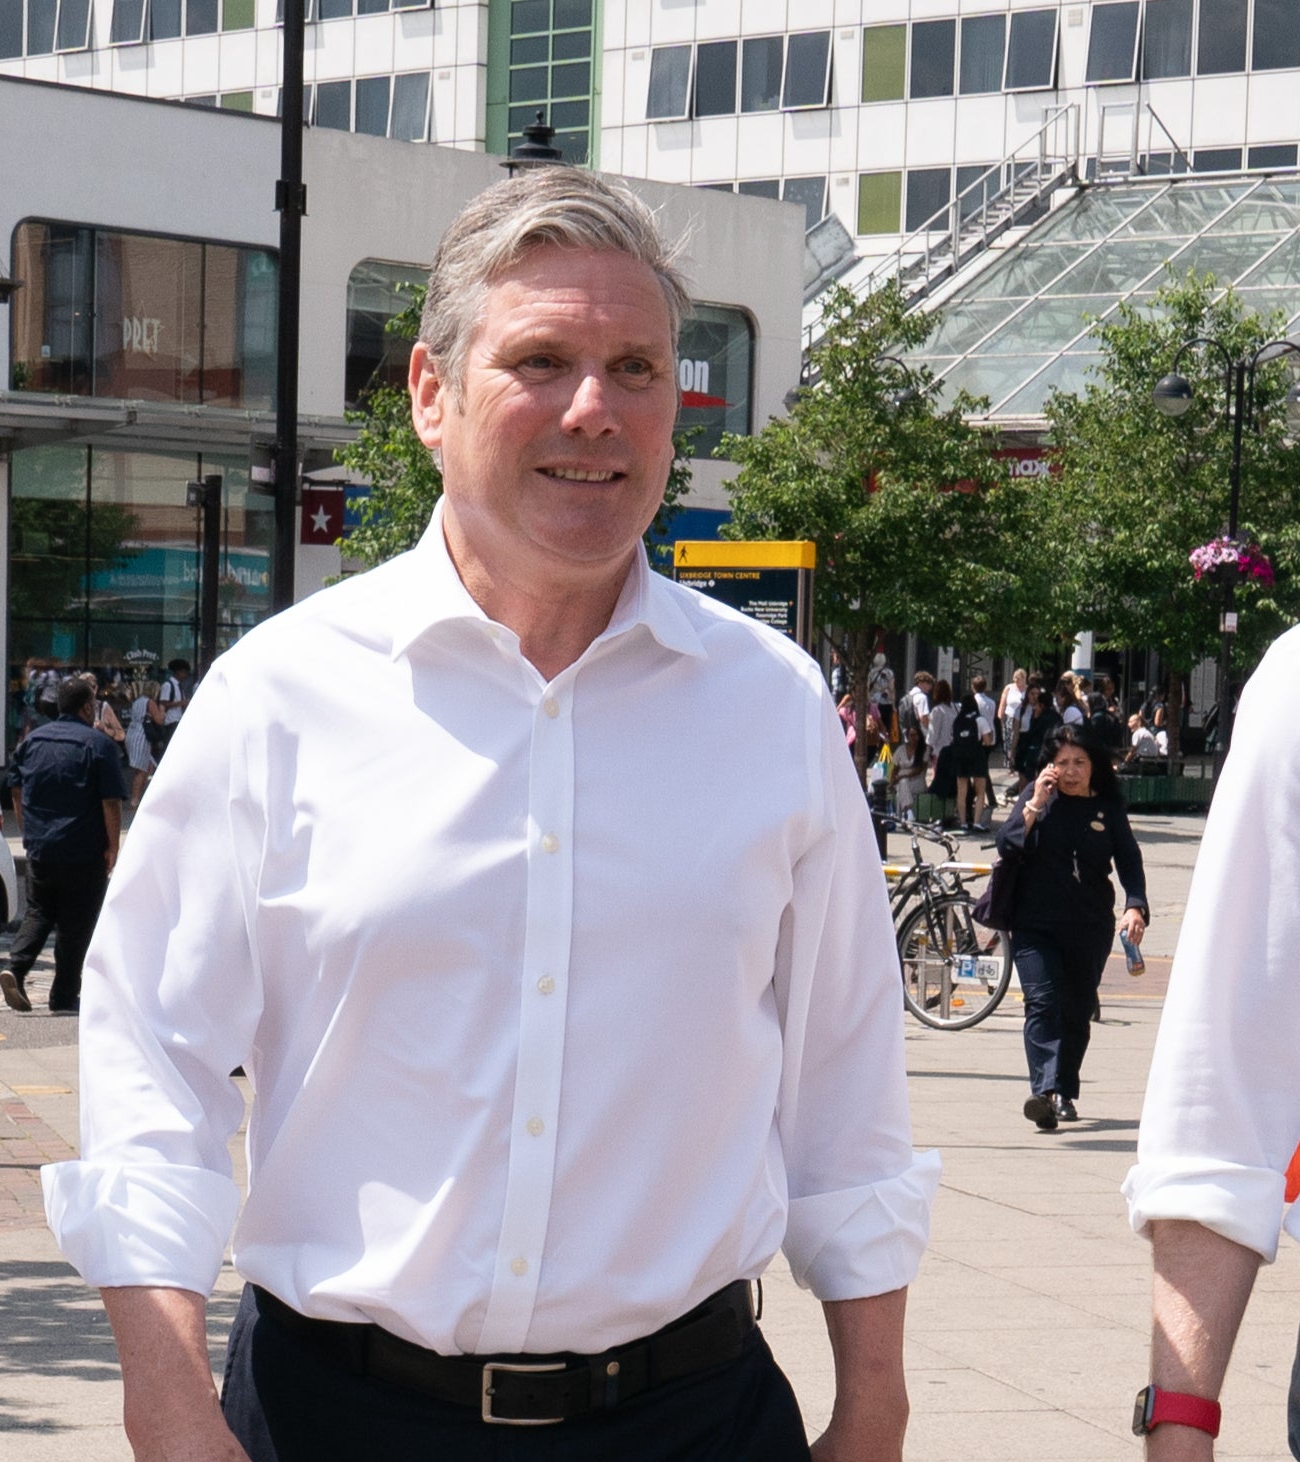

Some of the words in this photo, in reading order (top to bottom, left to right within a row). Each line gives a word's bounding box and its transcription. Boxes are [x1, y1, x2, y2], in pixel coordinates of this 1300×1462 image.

[123, 315, 161, 353] PRET
[680, 358, 709, 394] on
[679, 571, 711, 579] UXBRIDGE
[713, 571, 734, 579] TOWN
[735, 571, 760, 579] CENTRE
